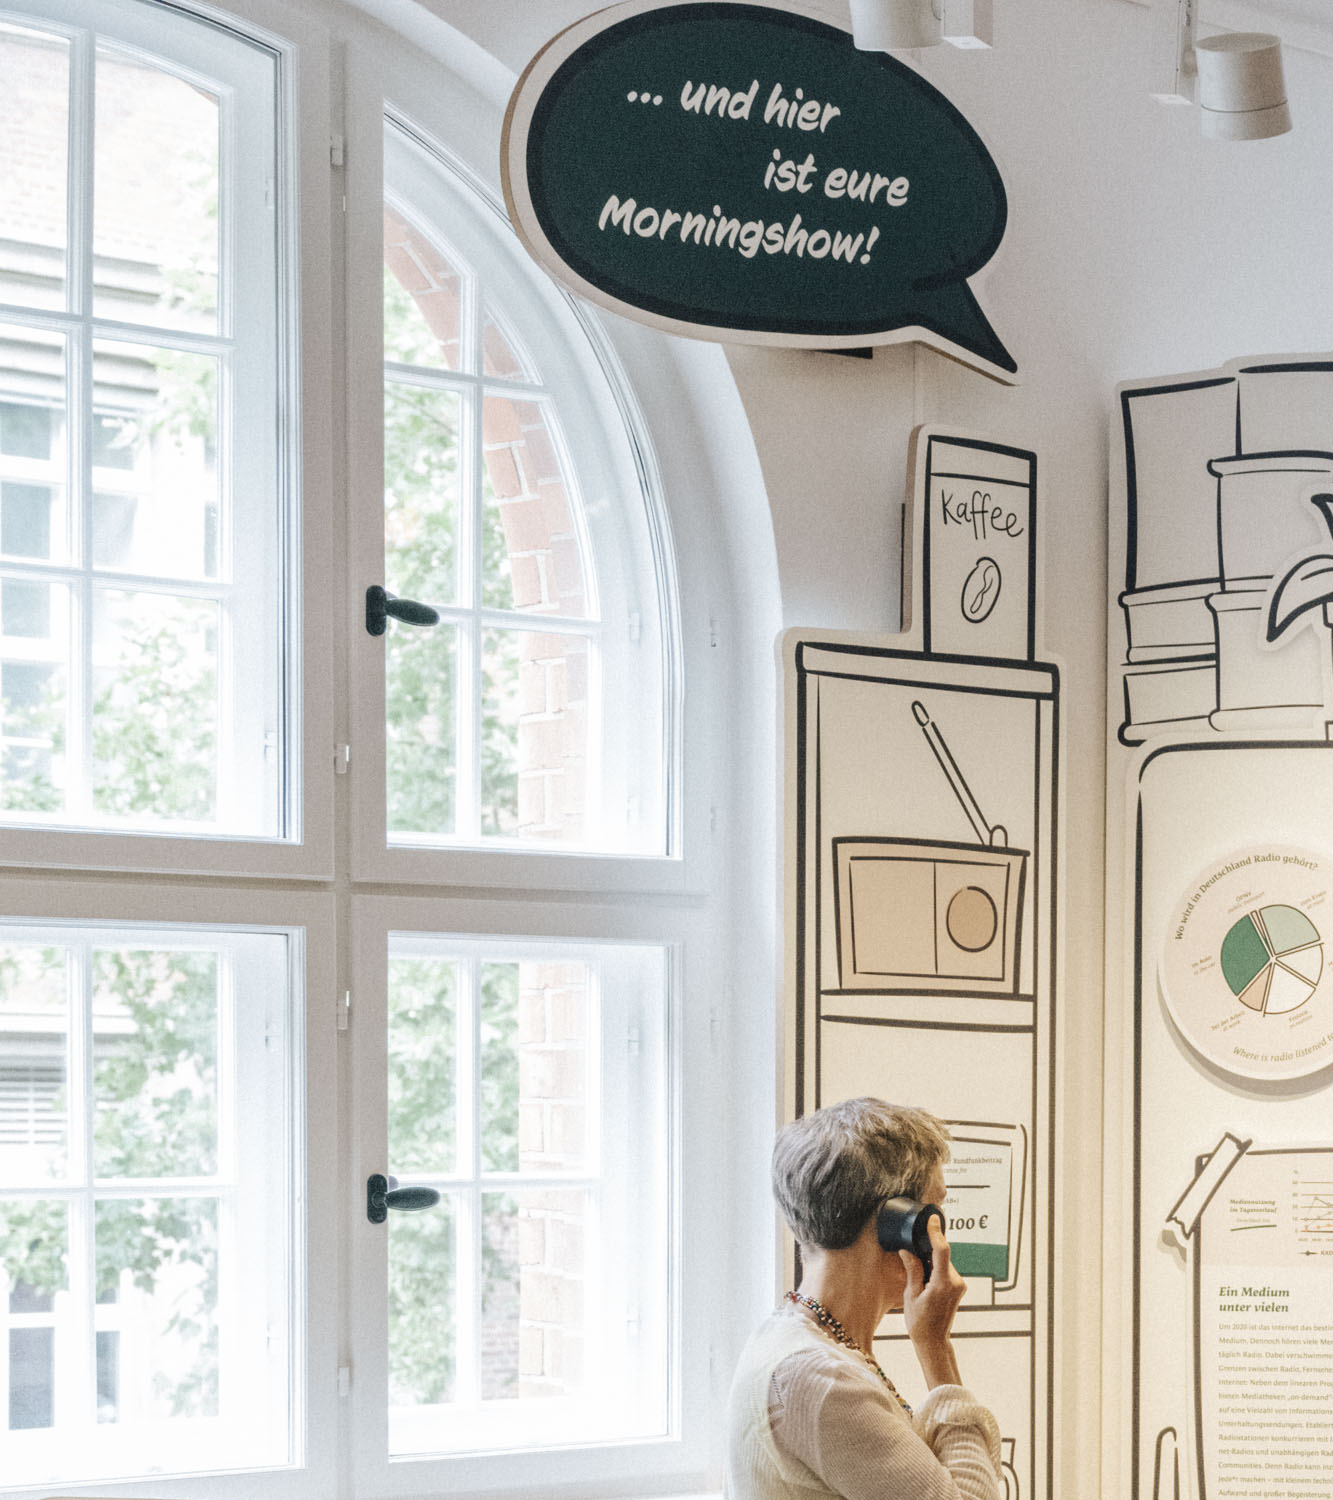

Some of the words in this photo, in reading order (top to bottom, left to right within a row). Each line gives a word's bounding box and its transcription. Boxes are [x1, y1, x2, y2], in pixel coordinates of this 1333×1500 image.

[627, 90, 662, 106] ...
[681, 79, 758, 121] und
[763, 83, 840, 133] hier
[764, 149, 817, 193] ist
[825, 167, 910, 206] eure
[598, 196, 880, 265] Morningshow!
[941, 489, 1024, 539] Kaffee
[1175, 924, 1185, 941] Wo
[1181, 903, 1194, 924] wird
[1194, 893, 1201, 904] in
[1199, 856, 1252, 894] Deutschland
[1254, 853, 1280, 864] Radio
[1283, 854, 1318, 871] gehört?
[1233, 1046, 1259, 1062] Where
[1261, 1053, 1268, 1062] is
[1270, 1049, 1293, 1062] radio
[1295, 1036, 1327, 1059] listened
[949, 1217, 975, 1231] 100
[978, 1214, 988, 1229] €
[1218, 1286, 1238, 1297] Ein
[1241, 1286, 1290, 1297] Medium
[1219, 1303, 1251, 1312] unter
[1254, 1302, 1289, 1313] vielen
